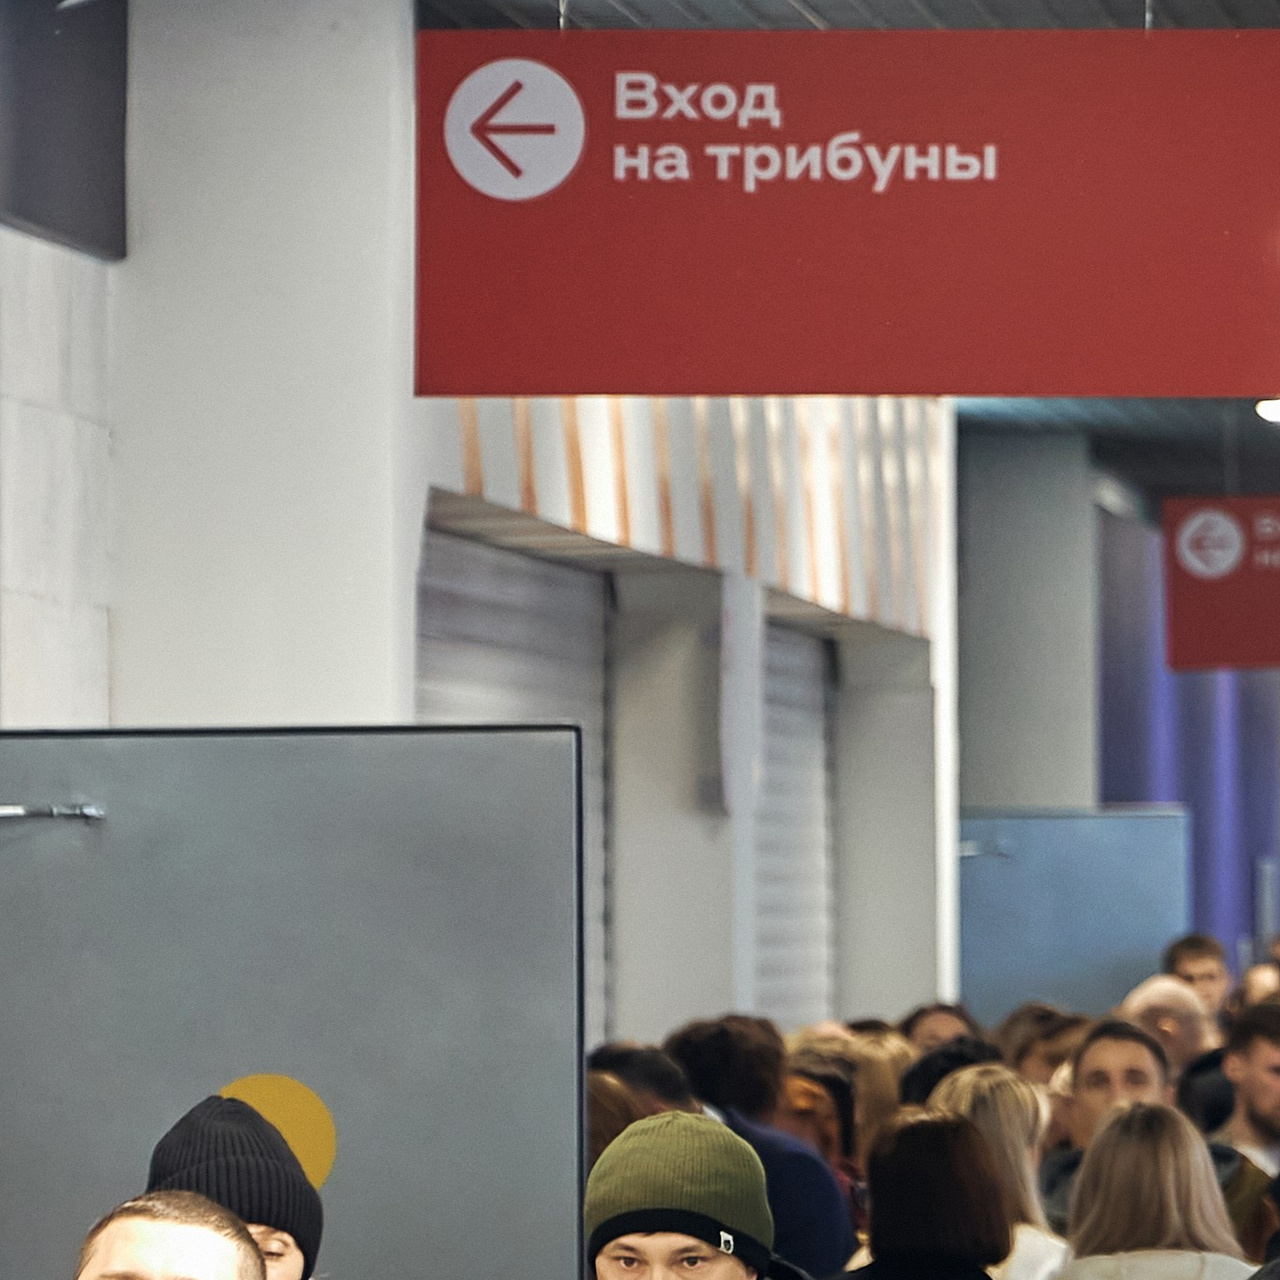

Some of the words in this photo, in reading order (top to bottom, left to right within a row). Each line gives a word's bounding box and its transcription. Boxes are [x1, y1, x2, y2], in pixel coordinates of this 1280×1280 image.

[613, 72, 781, 128] Вход
[613, 143, 690, 181] на
[706, 130, 998, 193] трибуны
